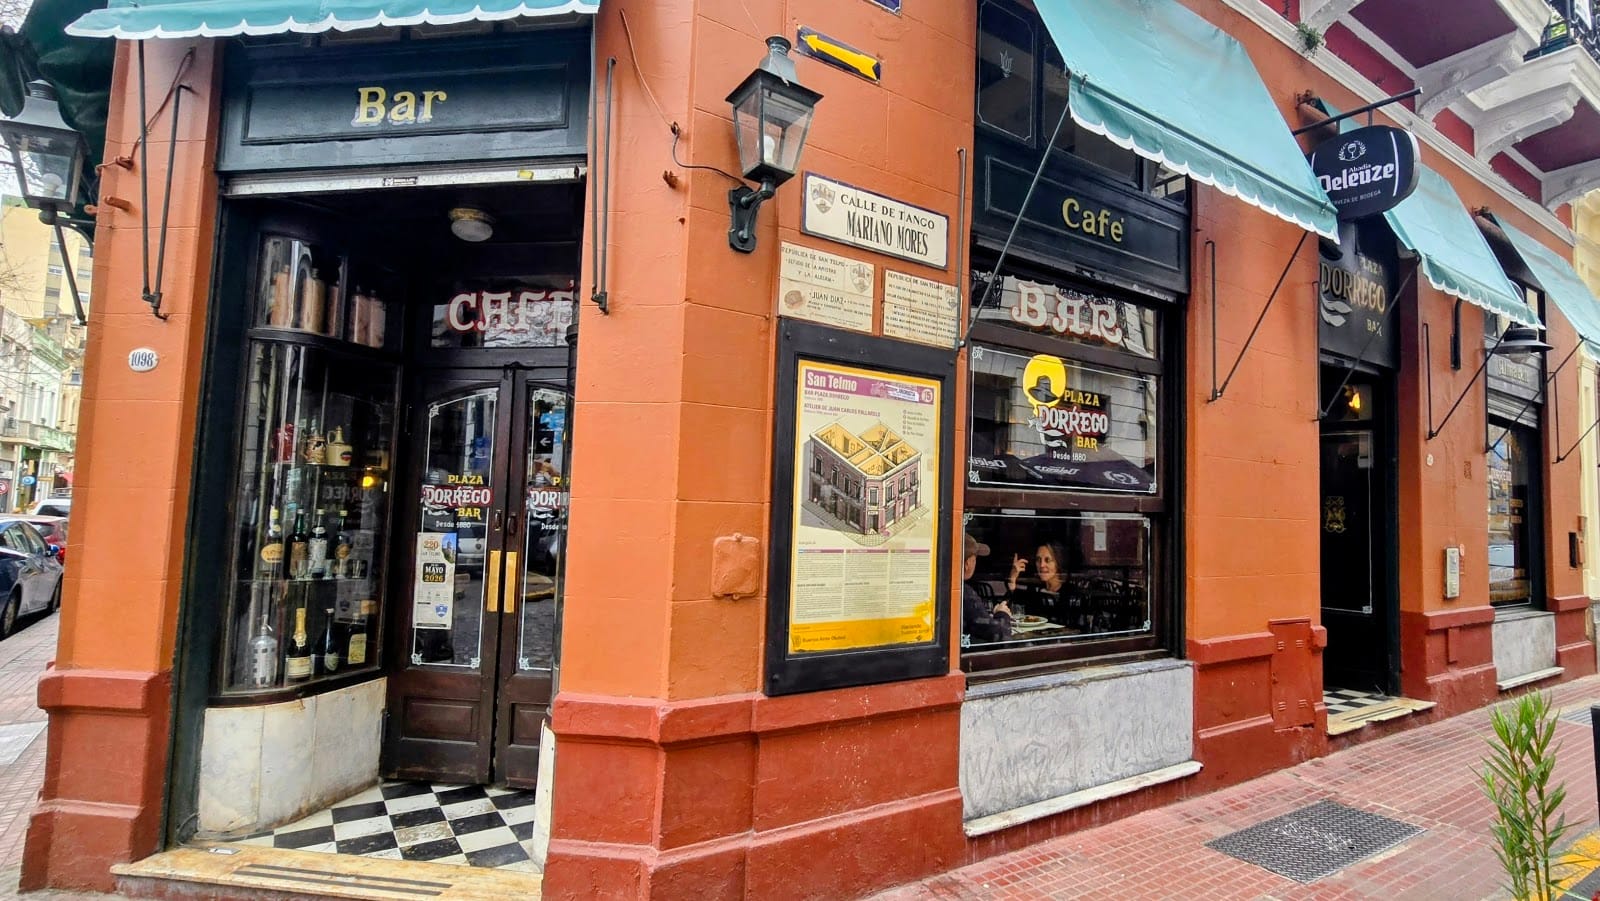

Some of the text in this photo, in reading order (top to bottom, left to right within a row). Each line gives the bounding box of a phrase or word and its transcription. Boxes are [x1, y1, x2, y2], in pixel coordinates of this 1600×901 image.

[351, 86, 448, 127] Bar
[1318, 163, 1395, 193] Deleuze
[1351, 195, 1359, 203] DE
[1360, 190, 1382, 201] BODEGA
[841, 194, 936, 230] CALLE DE TANGO
[1062, 198, 1125, 242] Café
[847, 210, 929, 256] MARIANO MORES
[810, 253, 817, 261] DE
[819, 255, 829, 263] SAN
[830, 257, 846, 268] TELMO
[920, 280, 929, 288] SAN
[929, 282, 944, 291] TELMO
[811, 291, 828, 301] JUAN
[1011, 282, 1124, 344] BAR
[131, 352, 154, 367] 1098
[807, 371, 857, 392] San Telmo
[814, 390, 829, 399] PLAZA
[1064, 390, 1101, 406] PLAZA
[1038, 406, 1109, 435] DORREGO
[1076, 436, 1099, 452] BAR
[1053, 450, 1087, 462] Desde 1880
[448, 475, 484, 484] PLAZA
[424, 486, 491, 507] DORREGO
[457, 508, 482, 520] BAR
[436, 521, 455, 529] Desde
[541, 522, 559, 530] Desde
[425, 566, 444, 575] MAYO
[424, 574, 444, 583] 2026
